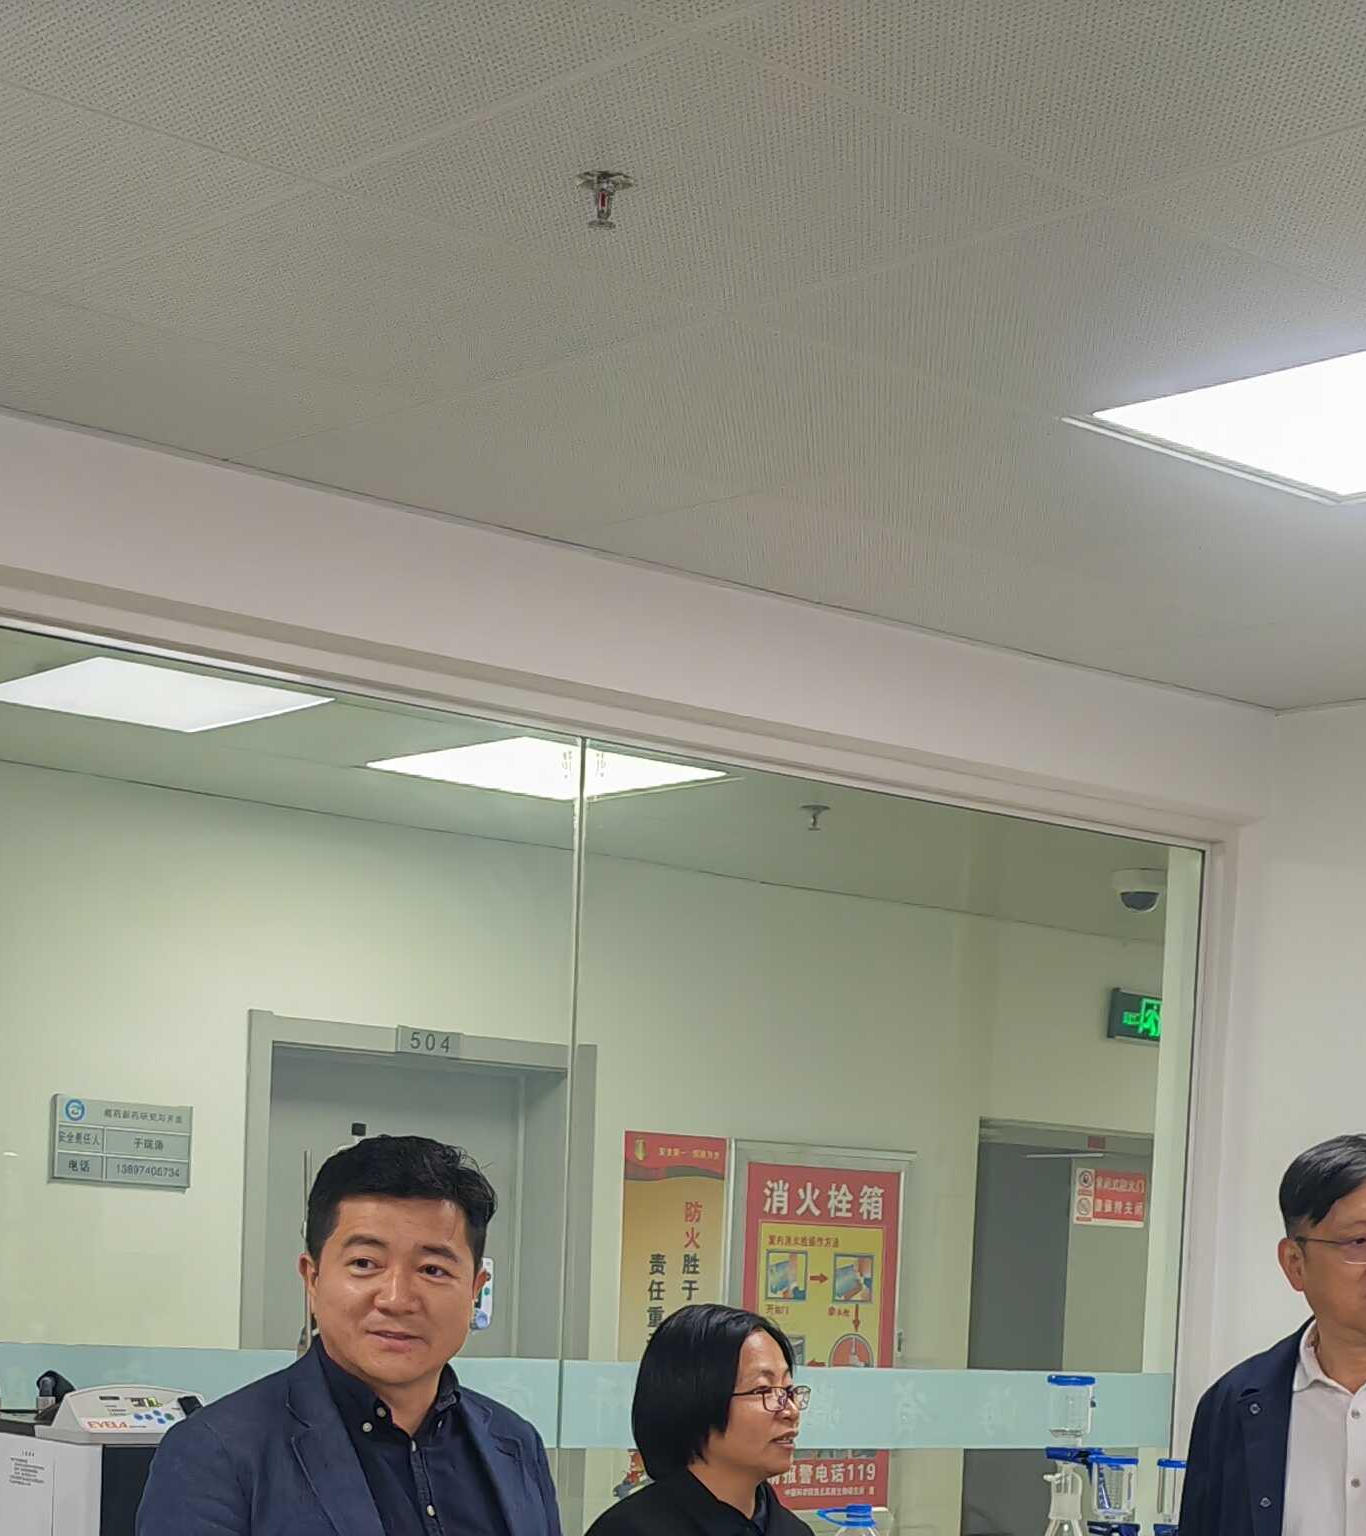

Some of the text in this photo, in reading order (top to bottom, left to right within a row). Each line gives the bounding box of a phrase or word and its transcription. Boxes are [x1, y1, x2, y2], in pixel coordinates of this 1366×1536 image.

[410, 1031, 450, 1053] 504
[58, 1130, 101, 1147] 安全责任人
[68, 1158, 90, 1173] 电话
[762, 1179, 885, 1221] 消火栓箱
[647, 1253, 667, 1344] 责任重
[87, 1420, 129, 1430] EYELA
